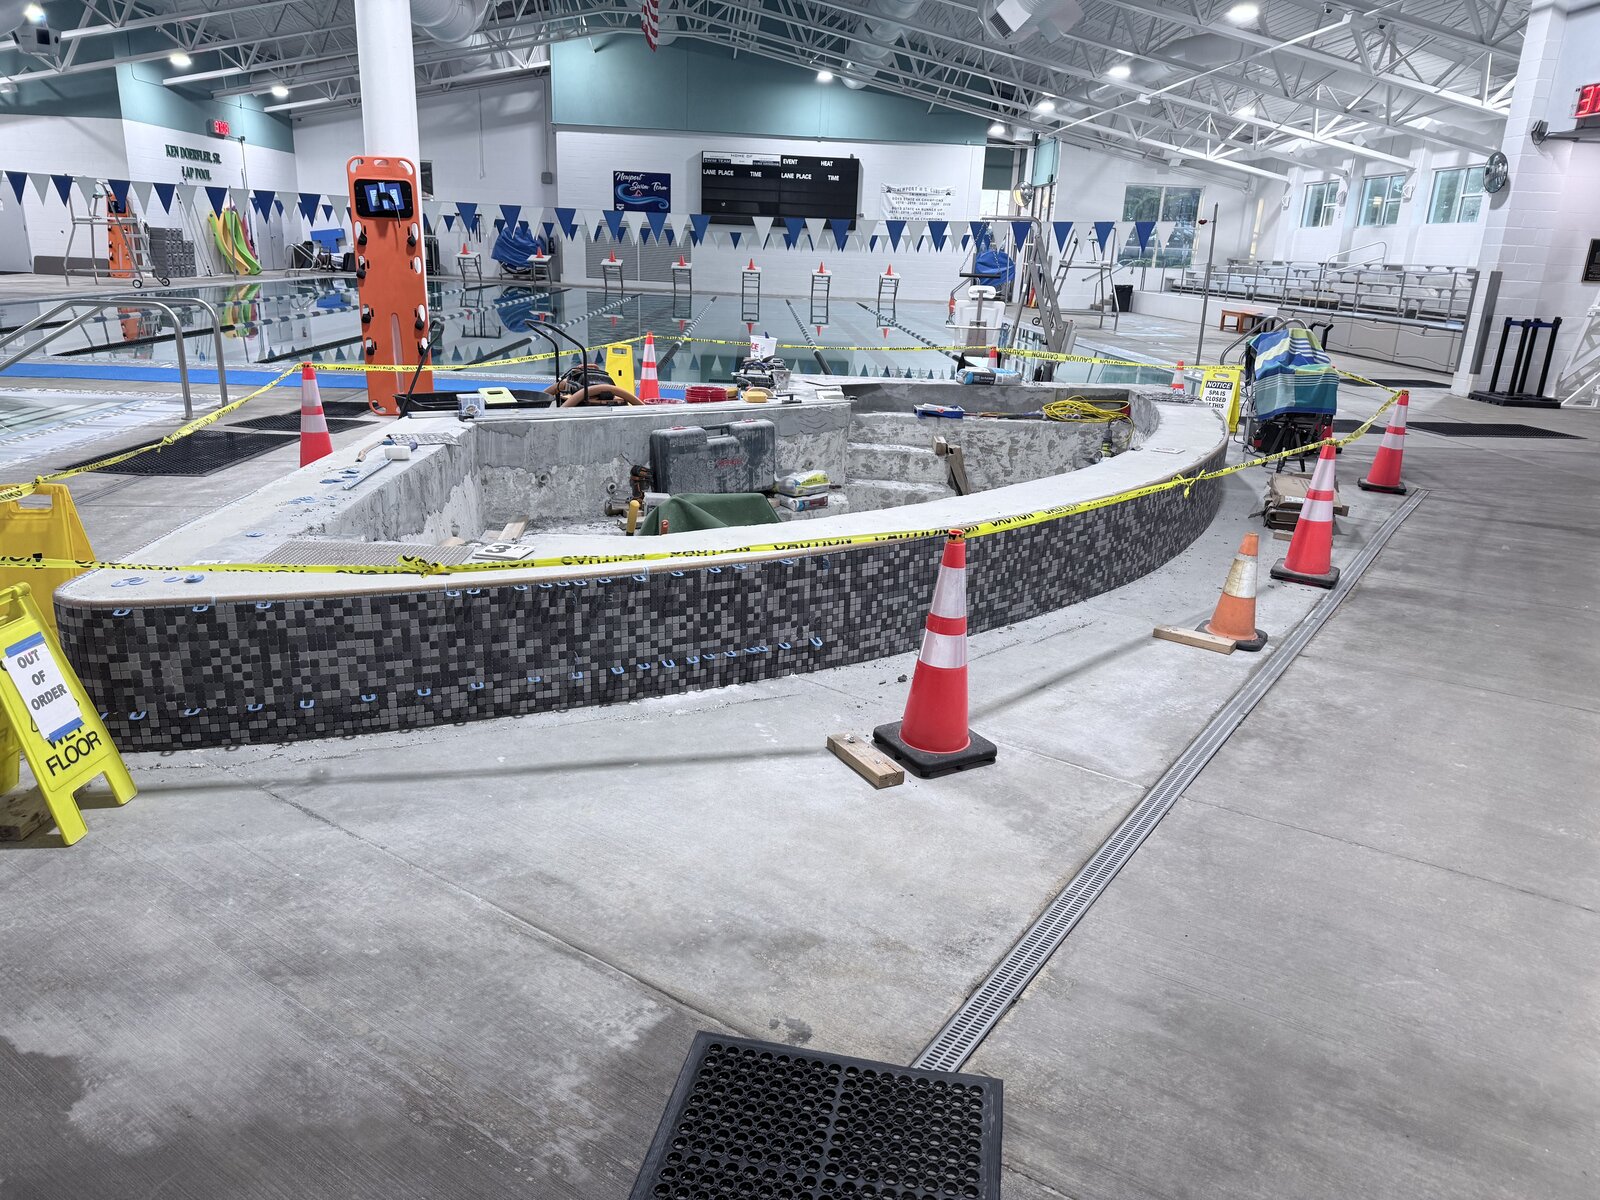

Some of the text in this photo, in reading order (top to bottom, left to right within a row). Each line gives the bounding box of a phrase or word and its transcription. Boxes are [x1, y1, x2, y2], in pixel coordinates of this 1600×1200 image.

[194, 167, 212, 180] POOL
[718, 169, 734, 177] PLACE
[1032, 351, 1059, 360] CAUTION
[1065, 355, 1093, 363] CAUTION
[1206, 381, 1233, 390] NOTICE
[485, 543, 511, 554] 3
[17, 649, 40, 669] OUT
[31, 670, 46, 686] OF
[31, 683, 67, 711] ORDER
[45, 730, 102, 777] FLOOR
